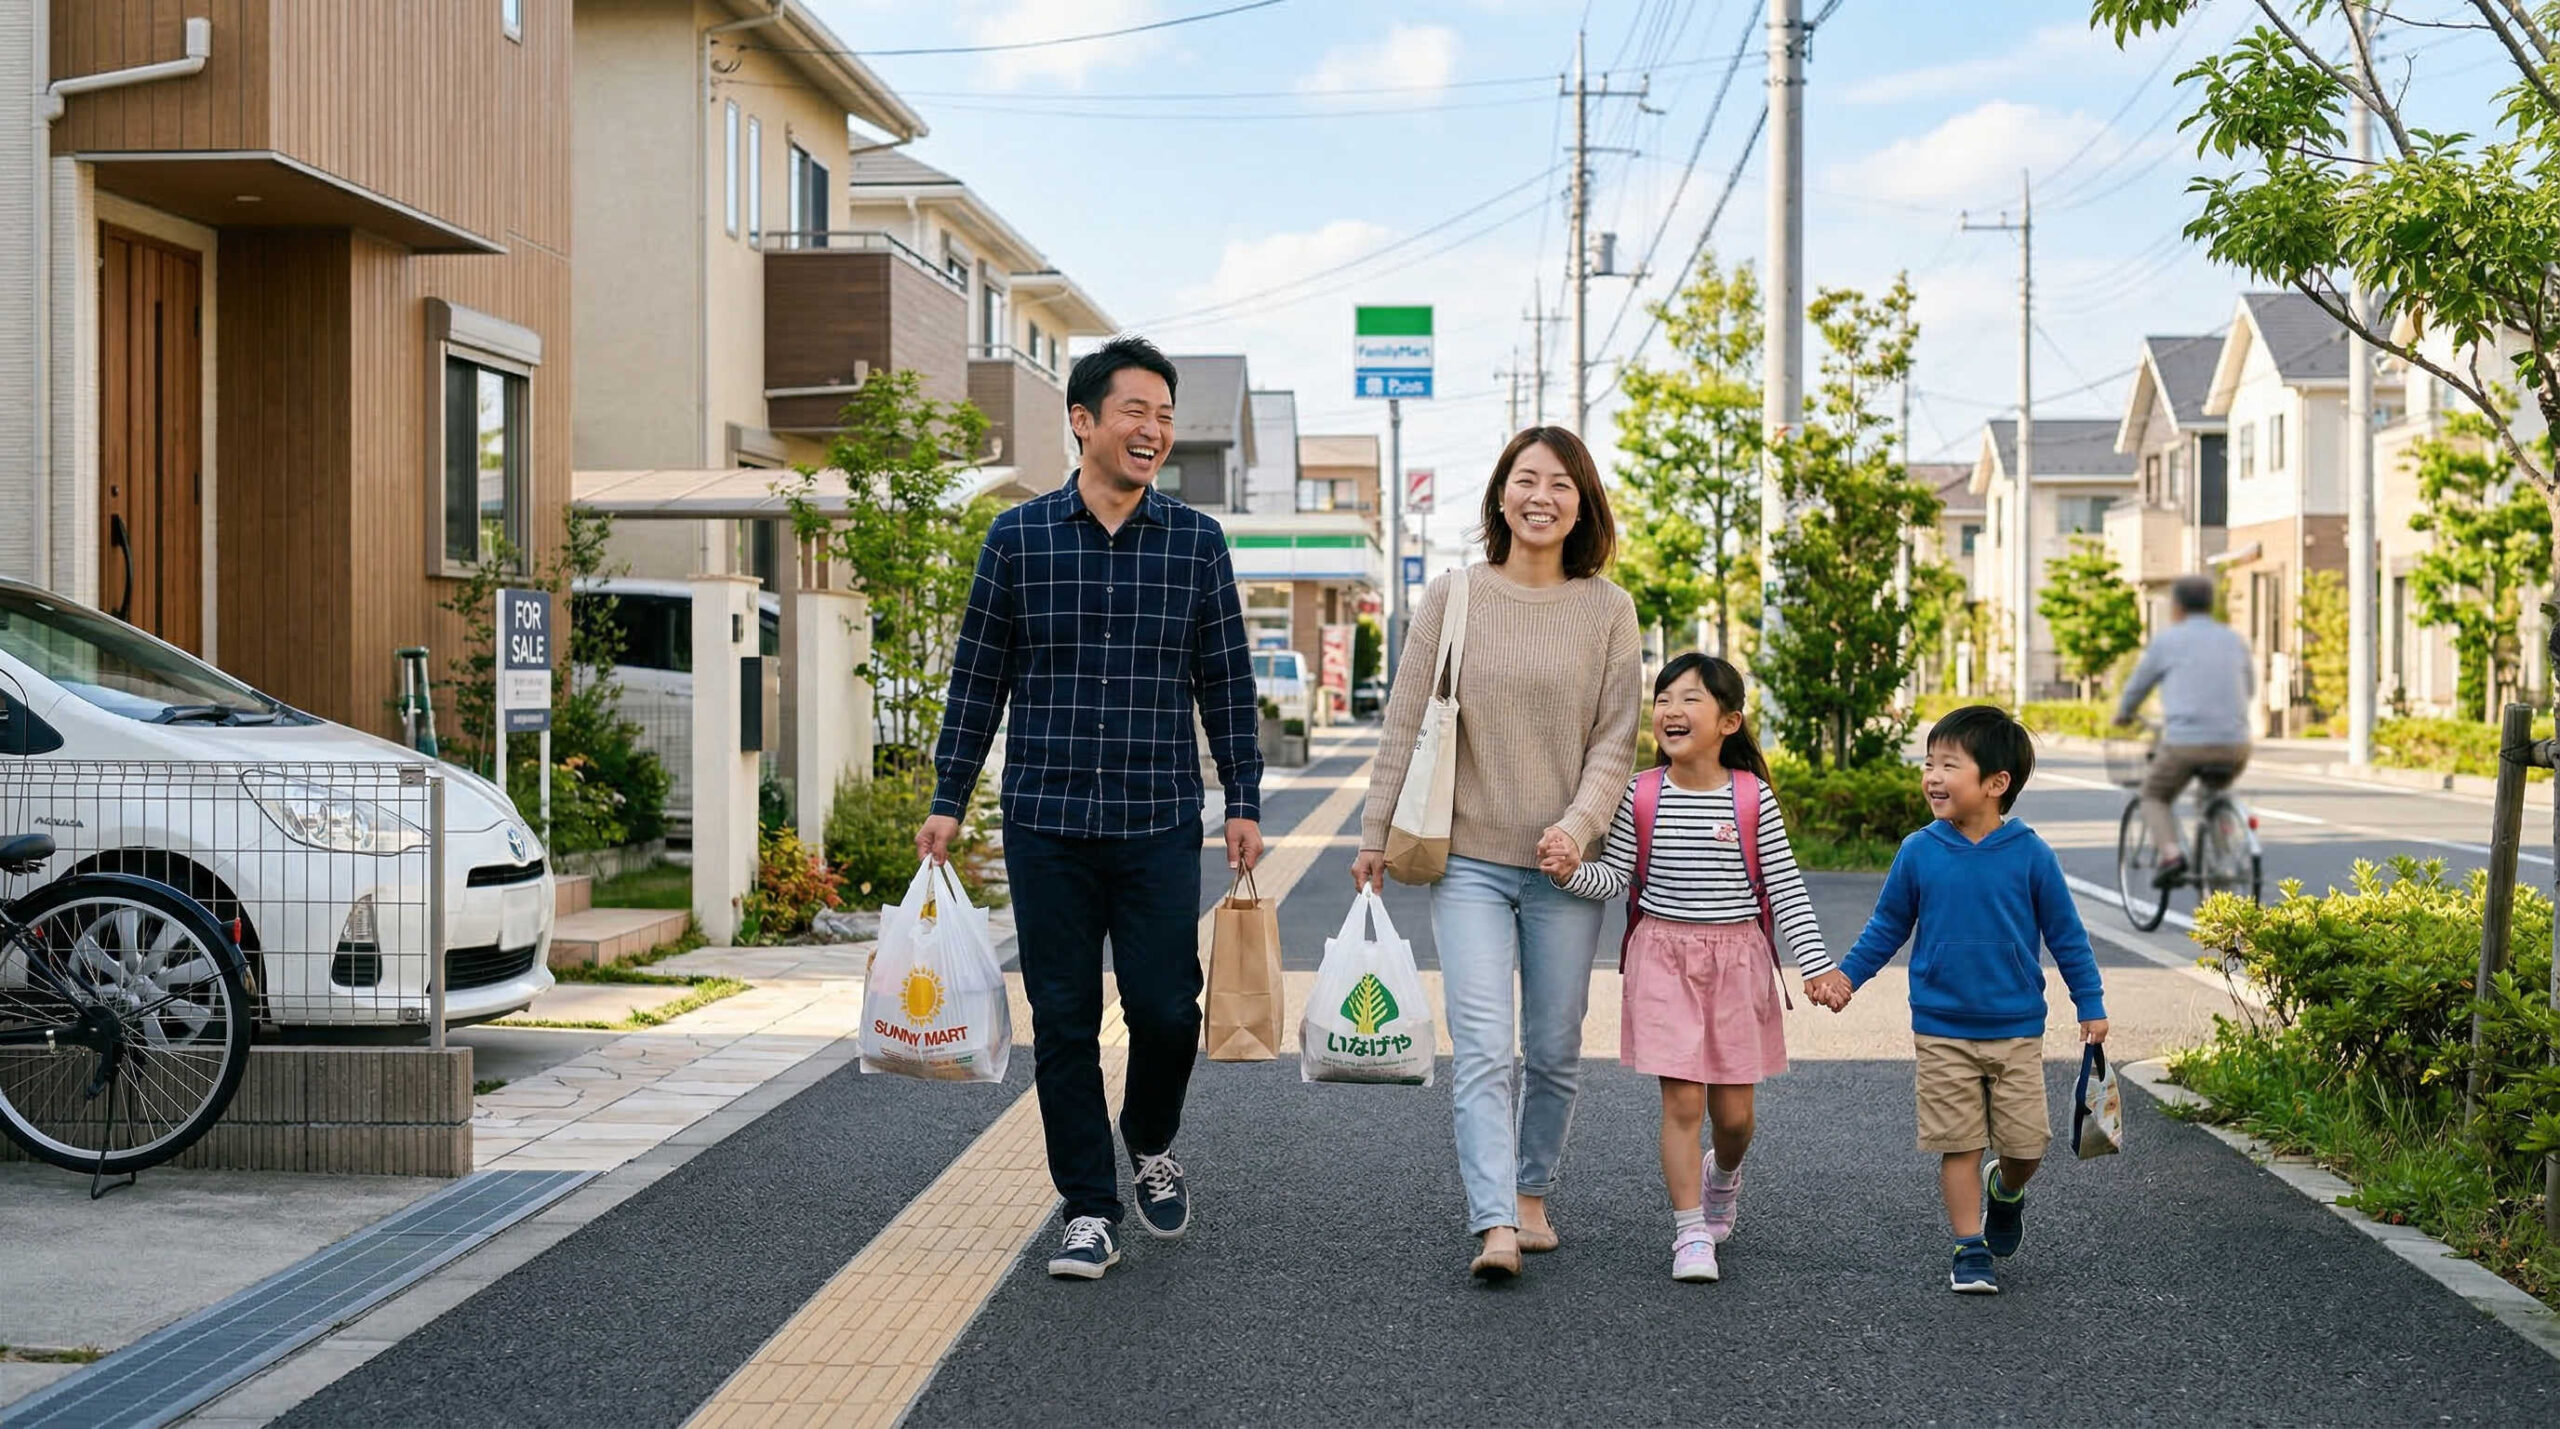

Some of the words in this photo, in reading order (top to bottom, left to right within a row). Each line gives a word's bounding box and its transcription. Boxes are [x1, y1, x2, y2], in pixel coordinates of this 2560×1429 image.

[515, 600, 542, 630] FOR
[512, 635, 545, 664] SALE
[874, 1019, 921, 1047] SUNNY
[924, 1026, 968, 1047] MART
[1327, 1032, 1413, 1057] いなげや
